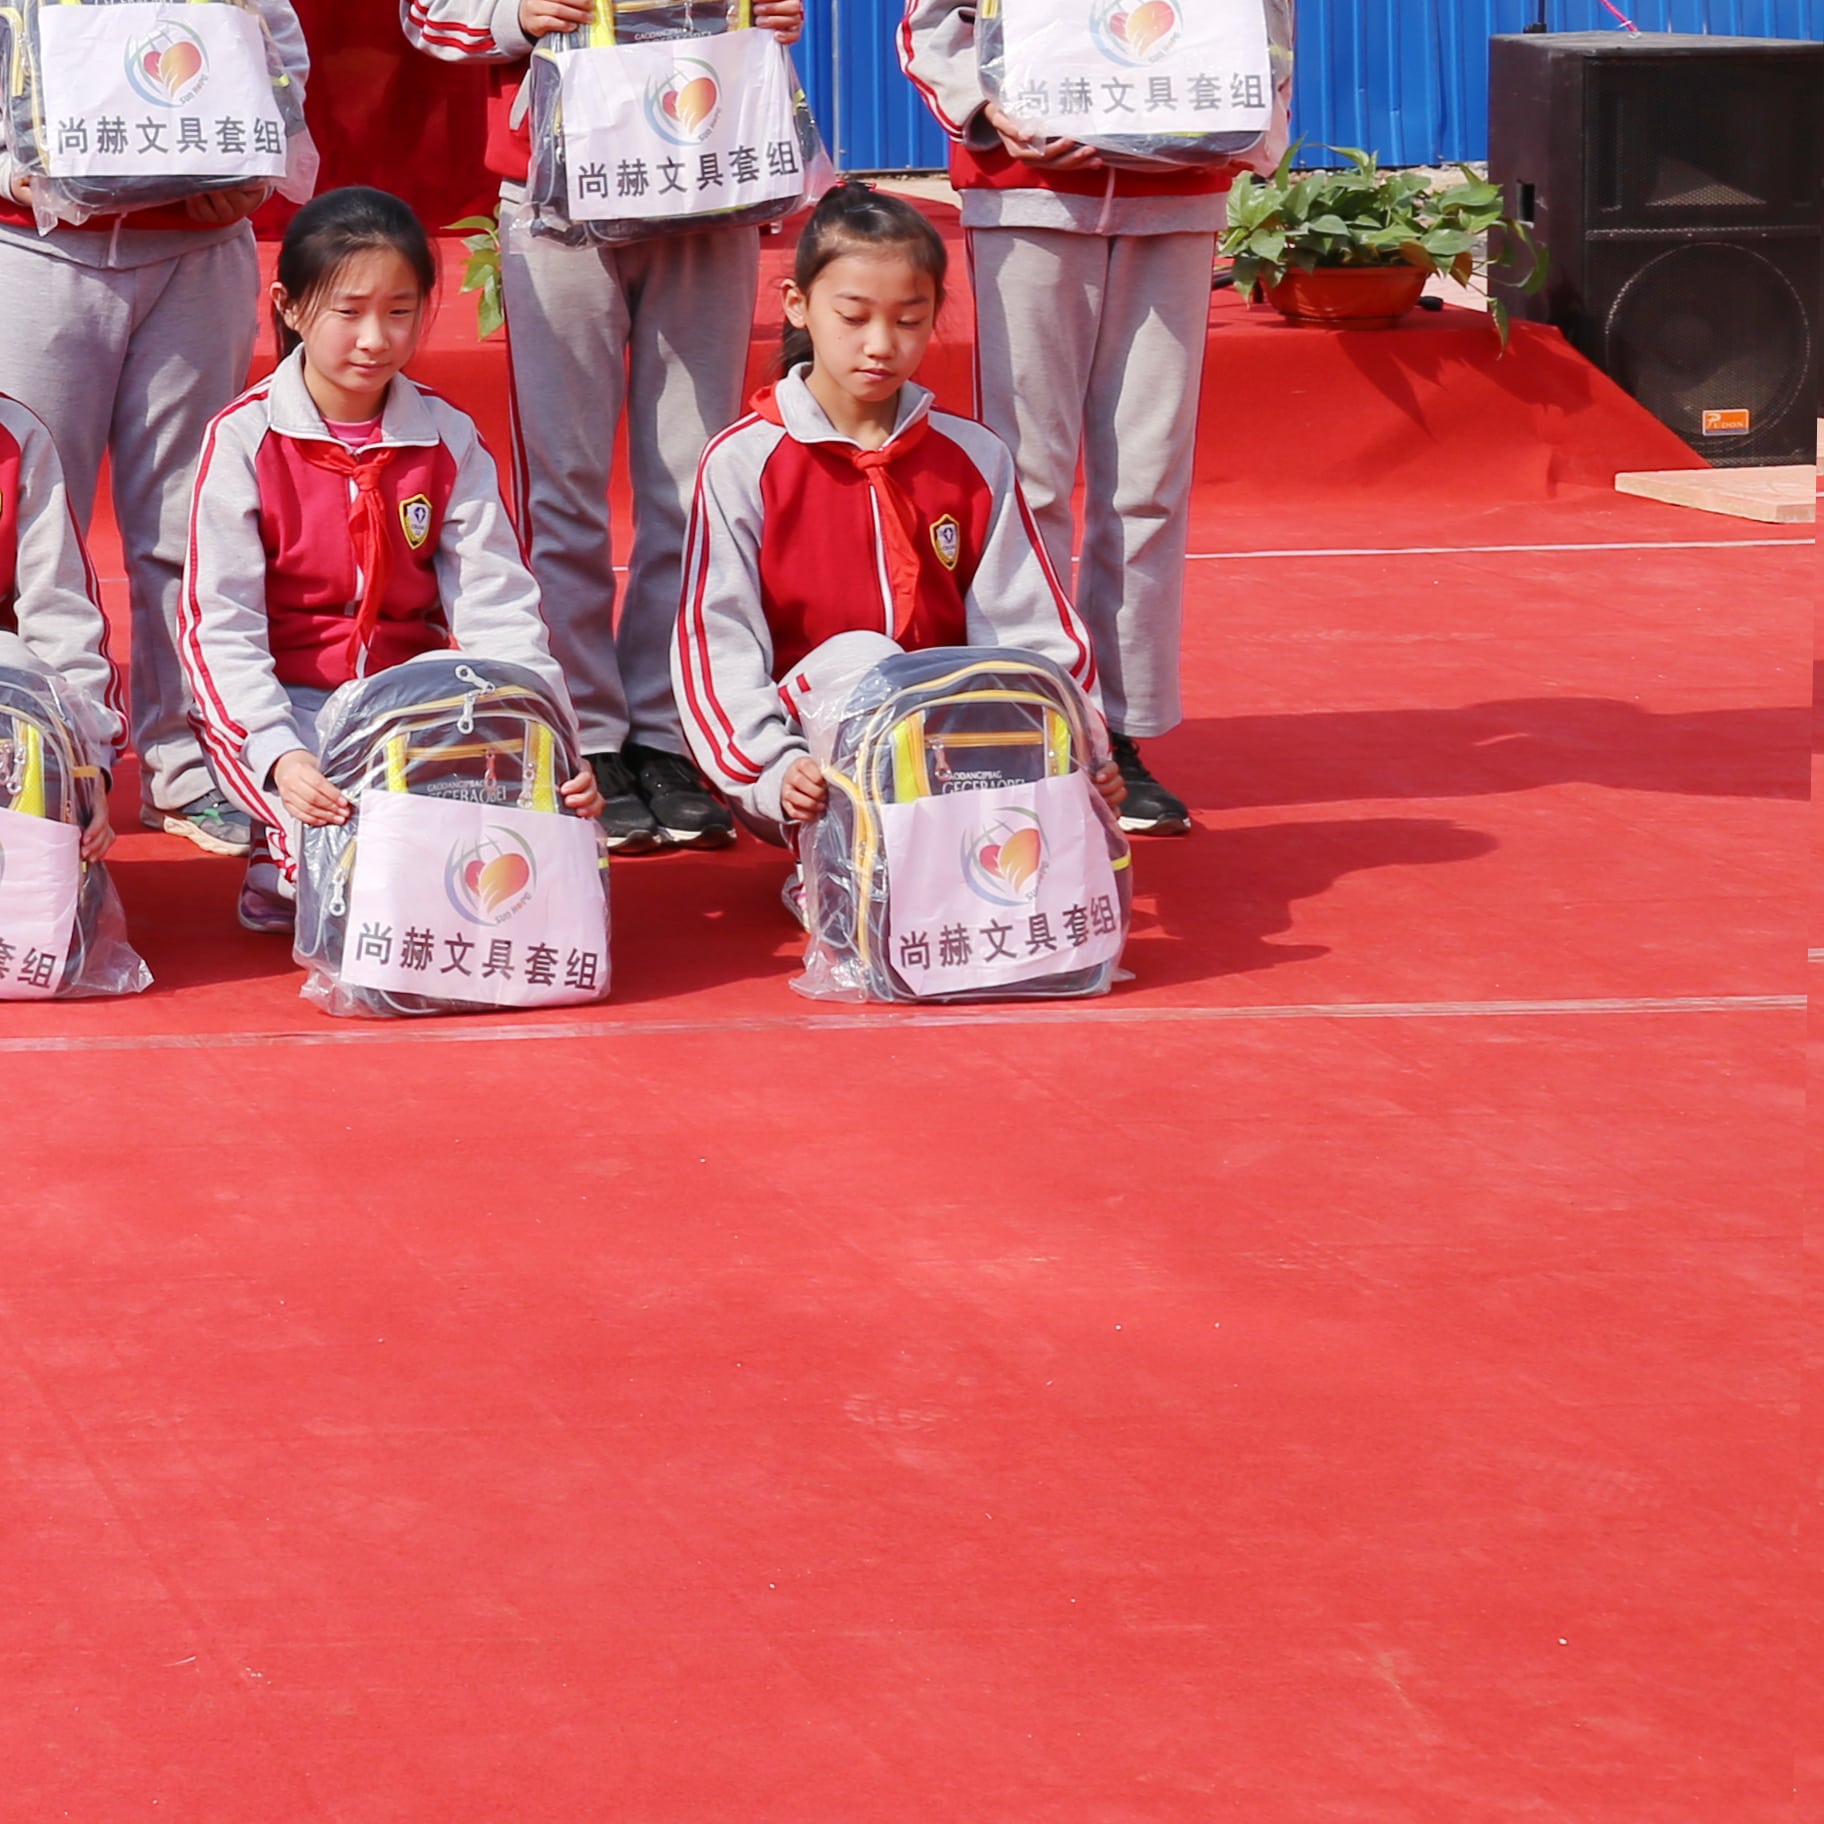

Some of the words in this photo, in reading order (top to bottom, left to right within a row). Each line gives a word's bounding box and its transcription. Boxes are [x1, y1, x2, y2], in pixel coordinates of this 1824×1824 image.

[1016, 71, 1266, 116] 尚赫文具套组
[57, 115, 283, 155] 尚赫文具套组
[578, 140, 799, 199] 尚赫文具套组
[355, 921, 599, 991] 尚赫文具套组
[899, 893, 1117, 971] 尚赫文具套组
